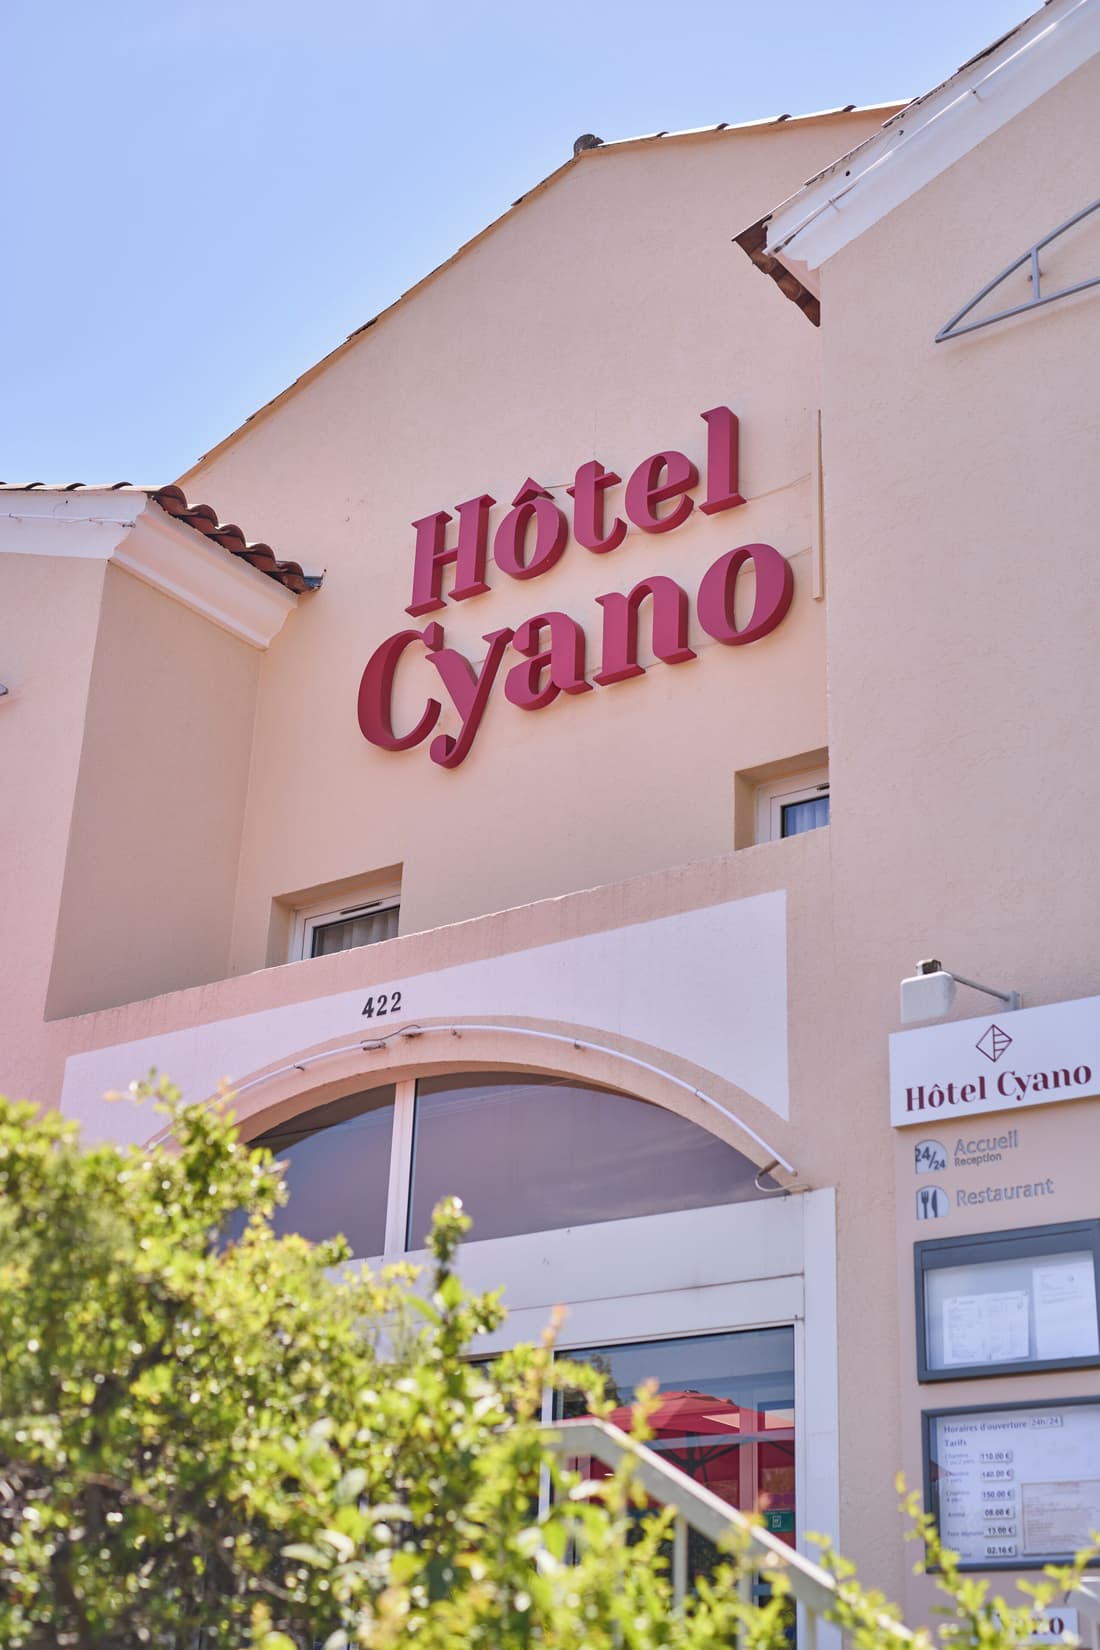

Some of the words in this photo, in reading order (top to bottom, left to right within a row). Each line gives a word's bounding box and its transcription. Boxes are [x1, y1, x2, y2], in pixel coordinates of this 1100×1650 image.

[404, 406, 747, 618] Hôtel
[357, 543, 795, 769] Cyano
[361, 991, 402, 1018] 422
[905, 1076, 987, 1112] Hôtel
[997, 1064, 1092, 1101] Cyano
[953, 1129, 1018, 1156] Accueil
[954, 1152, 1002, 1168] Reception
[956, 1178, 1054, 1207] Restaurant
[943, 1423, 978, 1433] Horaires
[979, 1421, 1027, 1432] d'ouverture
[944, 1439, 968, 1448] Tarifs
